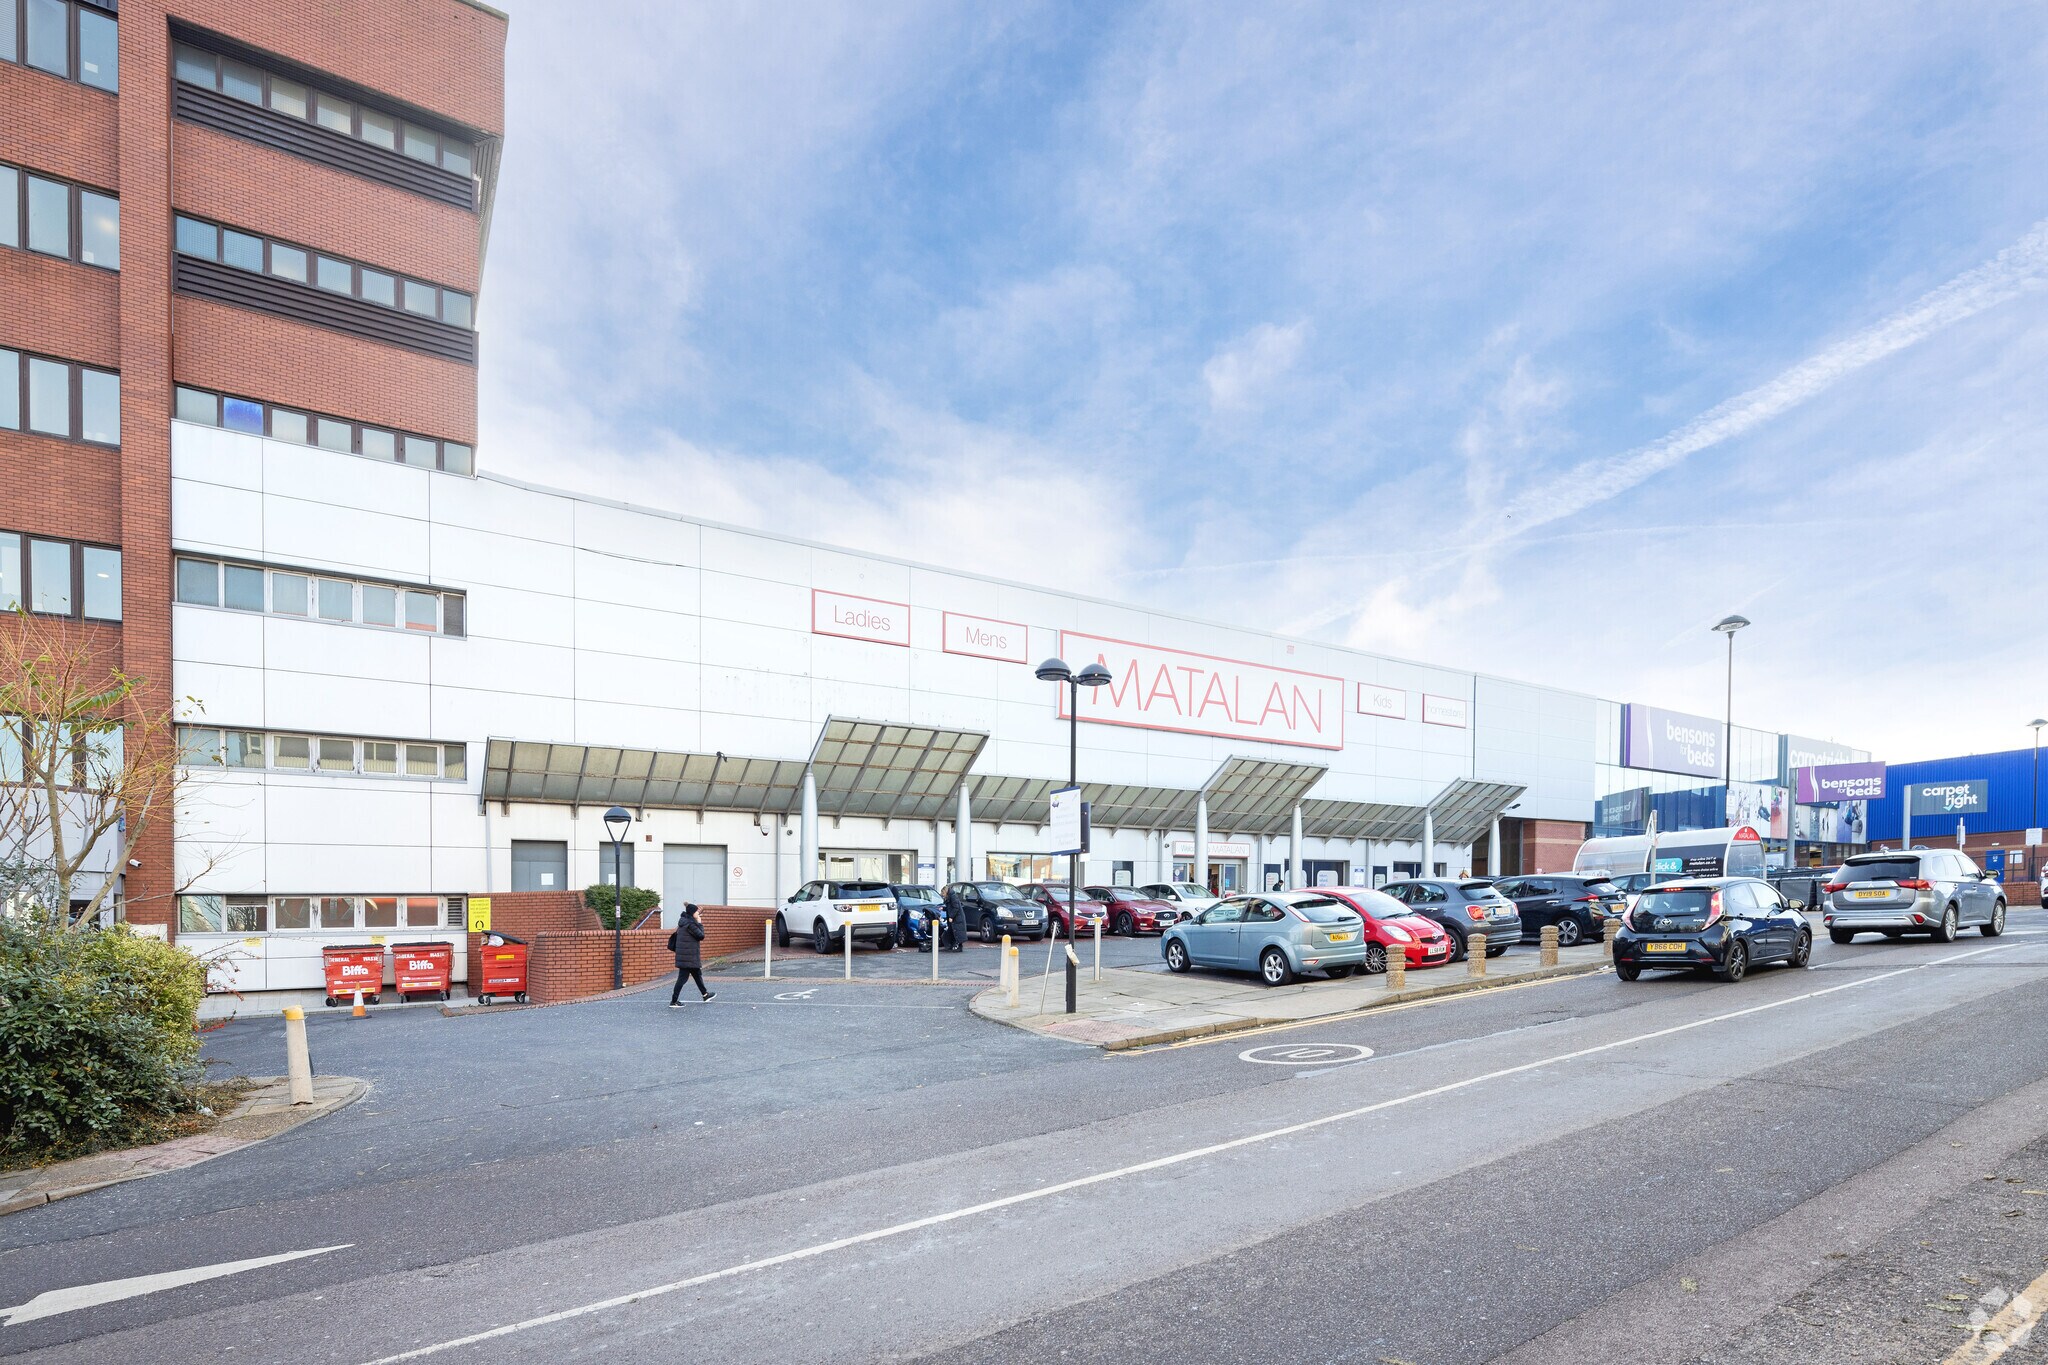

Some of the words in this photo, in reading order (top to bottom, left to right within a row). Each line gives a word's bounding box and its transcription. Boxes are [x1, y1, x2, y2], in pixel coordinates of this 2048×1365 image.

[833, 605, 891, 632] Ladies
[965, 626, 1008, 650] Mens
[1092, 653, 1323, 734] MATALAN
[1373, 693, 1393, 710] Kids
[1666, 719, 1716, 748] bensons
[1679, 743, 1688, 756] for
[1687, 744, 1715, 768] beds
[1821, 776, 1882, 790] bensons
[1837, 786, 1846, 795] for
[1846, 785, 1882, 797] beds
[1922, 784, 1970, 799] carpet
[1945, 793, 1978, 810] right
[1213, 845, 1246, 855] MATALAN
[1670, 861, 1677, 870] &
[342, 965, 369, 976] Biffa
[409, 960, 434, 971] Biffa
